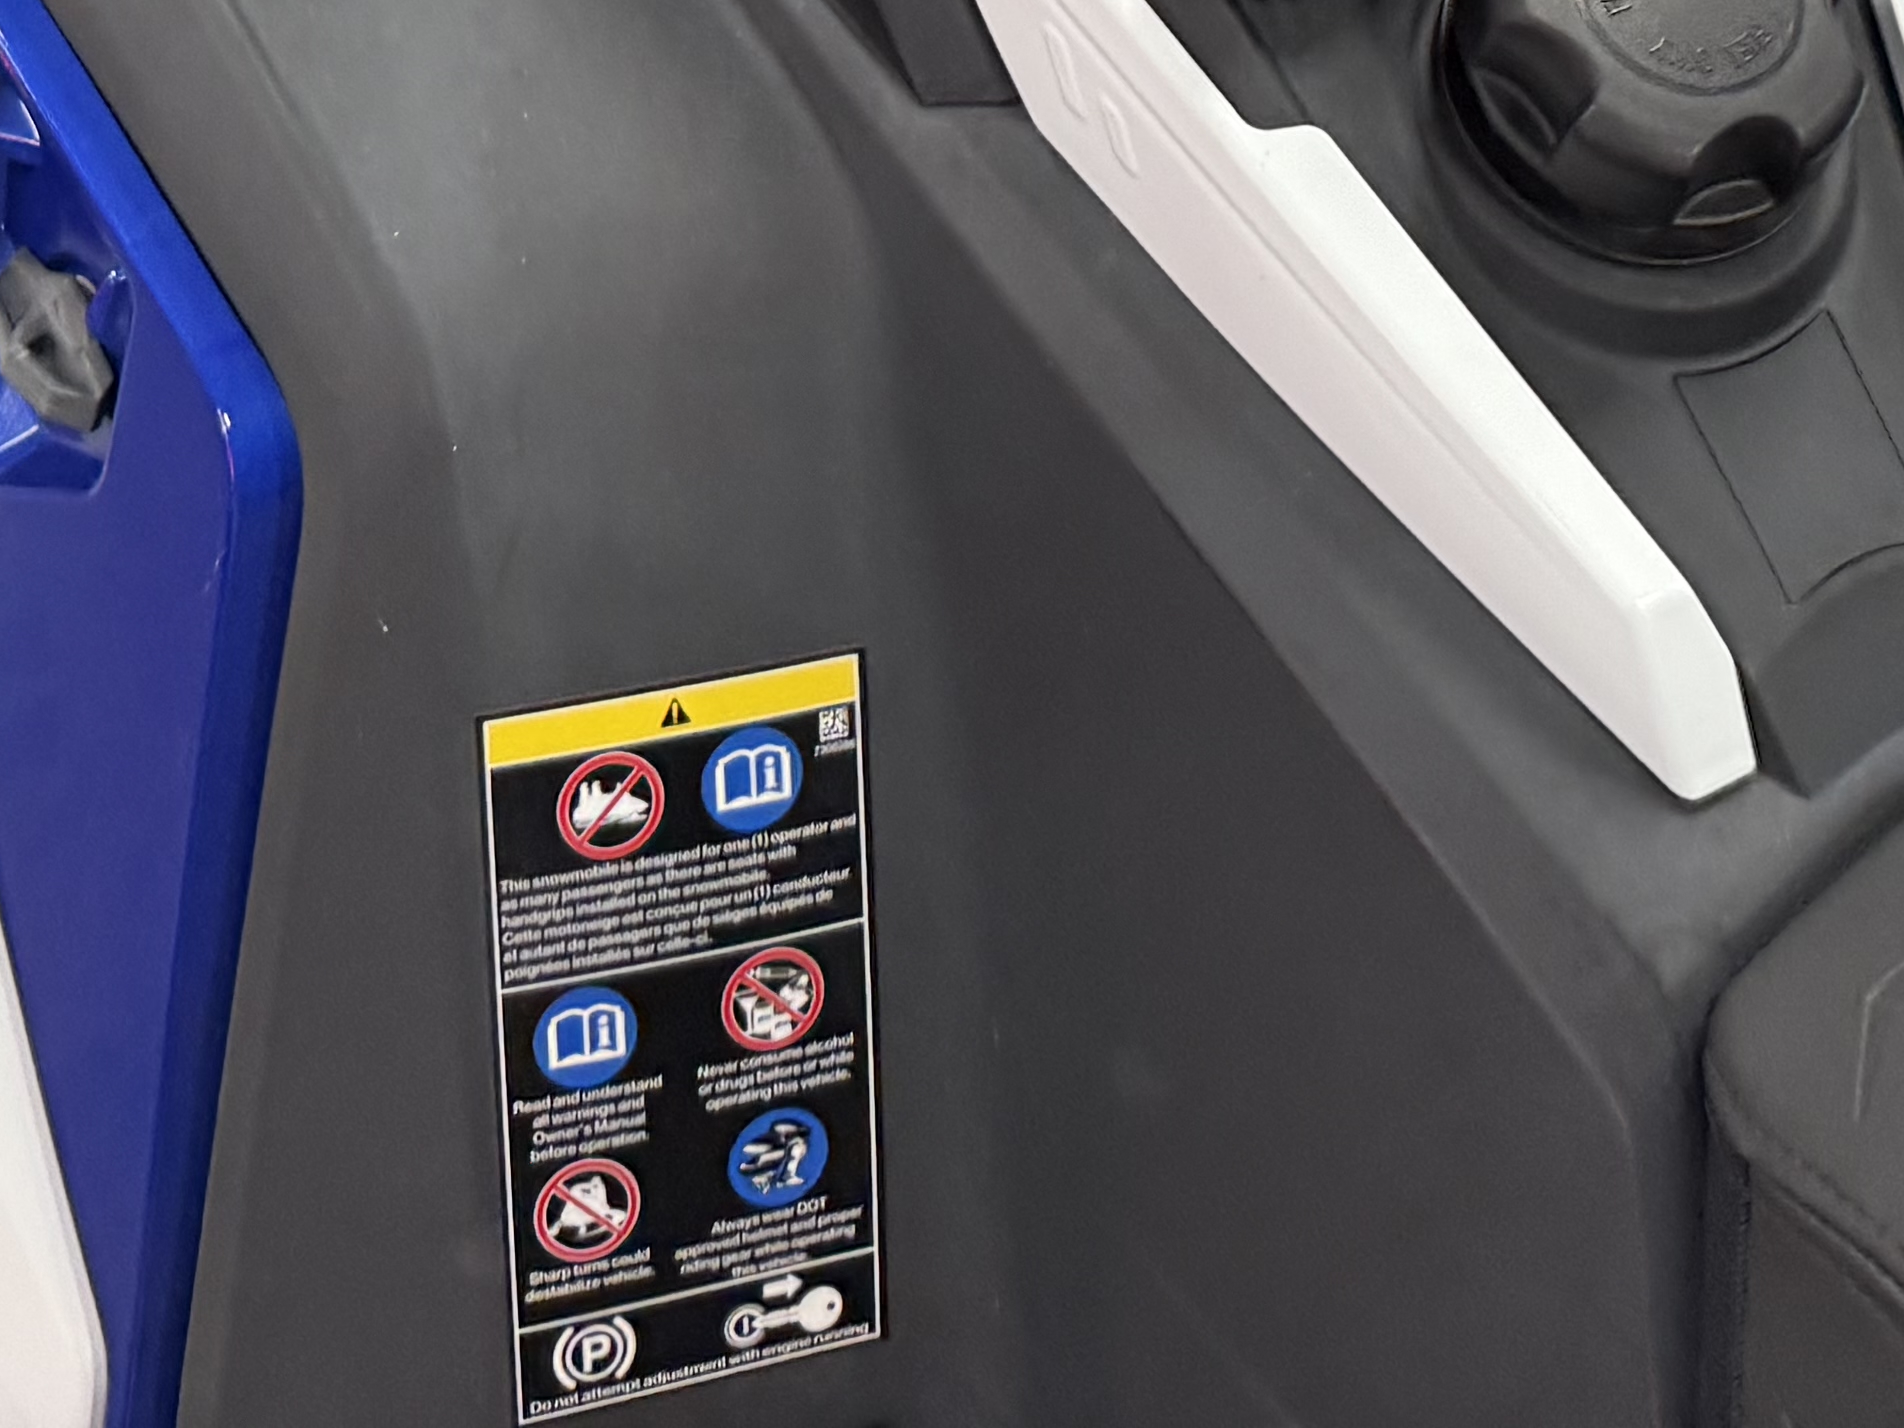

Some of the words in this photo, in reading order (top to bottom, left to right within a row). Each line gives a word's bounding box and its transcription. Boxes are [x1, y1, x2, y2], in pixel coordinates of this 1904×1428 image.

[499, 877, 530, 893] This
[532, 861, 619, 889] snowmobile
[621, 859, 633, 873] is
[635, 845, 700, 870] designed
[703, 843, 721, 859] for
[723, 838, 749, 853] one
[752, 830, 769, 848] (1)
[770, 819, 828, 843] operator
[830, 813, 856, 830] and
[501, 898, 517, 912] as
[520, 890, 560, 910] many
[561, 876, 644, 900] passengers
[646, 872, 663, 886] as
[665, 865, 701, 882] there
[703, 860, 726, 875] are
[728, 852, 766, 869] seats
[767, 844, 796, 860] with
[501, 906, 574, 929] handgrips
[575, 892, 636, 915] installed
[637, 890, 656, 904] on
[658, 885, 681, 901] the
[502, 928, 542, 946] Cette
[544, 914, 620, 941] motoneige
[621, 909, 643, 925] est
[645, 901, 698, 921] conçue
[699, 893, 732, 913] pour
[734, 888, 752, 904] un
[754, 883, 770, 901] (1)
[773, 867, 851, 895] conducteur
[519, 940, 565, 961] autant
[567, 936, 586, 952] de
[588, 925, 661, 952] passagers
[663, 918, 691, 937] que
[692, 913, 711, 930] de
[815, 887, 834, 902] de
[633, 941, 656, 956] sur
[697, 1059, 739, 1080] Never
[740, 1046, 803, 1071] consume
[804, 1031, 854, 1055] alcohol
[698, 1082, 713, 1096] or
[715, 1072, 755, 1094] drugs
[756, 1062, 801, 1084] before
[819, 1049, 854, 1069] while
[512, 1094, 551, 1115] Read
[553, 1089, 580, 1109] and
[582, 1072, 663, 1101] understand
[532, 1113, 551, 1129] all
[552, 1100, 616, 1126] warnings
[617, 1094, 645, 1112] and
[705, 1086, 772, 1113] operating
[773, 1078, 798, 1094] this
[530, 1143, 577, 1164] before
[578, 1129, 650, 1155] operation.
[532, 1122, 593, 1145] Owner's
[594, 1111, 646, 1134] Manual
[674, 1233, 740, 1261] approved
[790, 1214, 816, 1232] and
[817, 1204, 864, 1230] proper
[711, 1212, 760, 1236] Always
[761, 1205, 794, 1224] wear
[796, 1195, 827, 1216] DOT
[529, 1265, 571, 1286] Sharp
[573, 1258, 610, 1277] turns
[611, 1246, 651, 1267] could
[721, 1247, 752, 1268] gear
[791, 1224, 856, 1250] operating
[529, 1398, 552, 1415] Do
[554, 1390, 579, 1409] not
[581, 1377, 641, 1401] attempt
[643, 1355, 726, 1388] adjustment
[728, 1344, 760, 1366] with
[762, 1334, 812, 1358] engine
[814, 1322, 869, 1346] running
